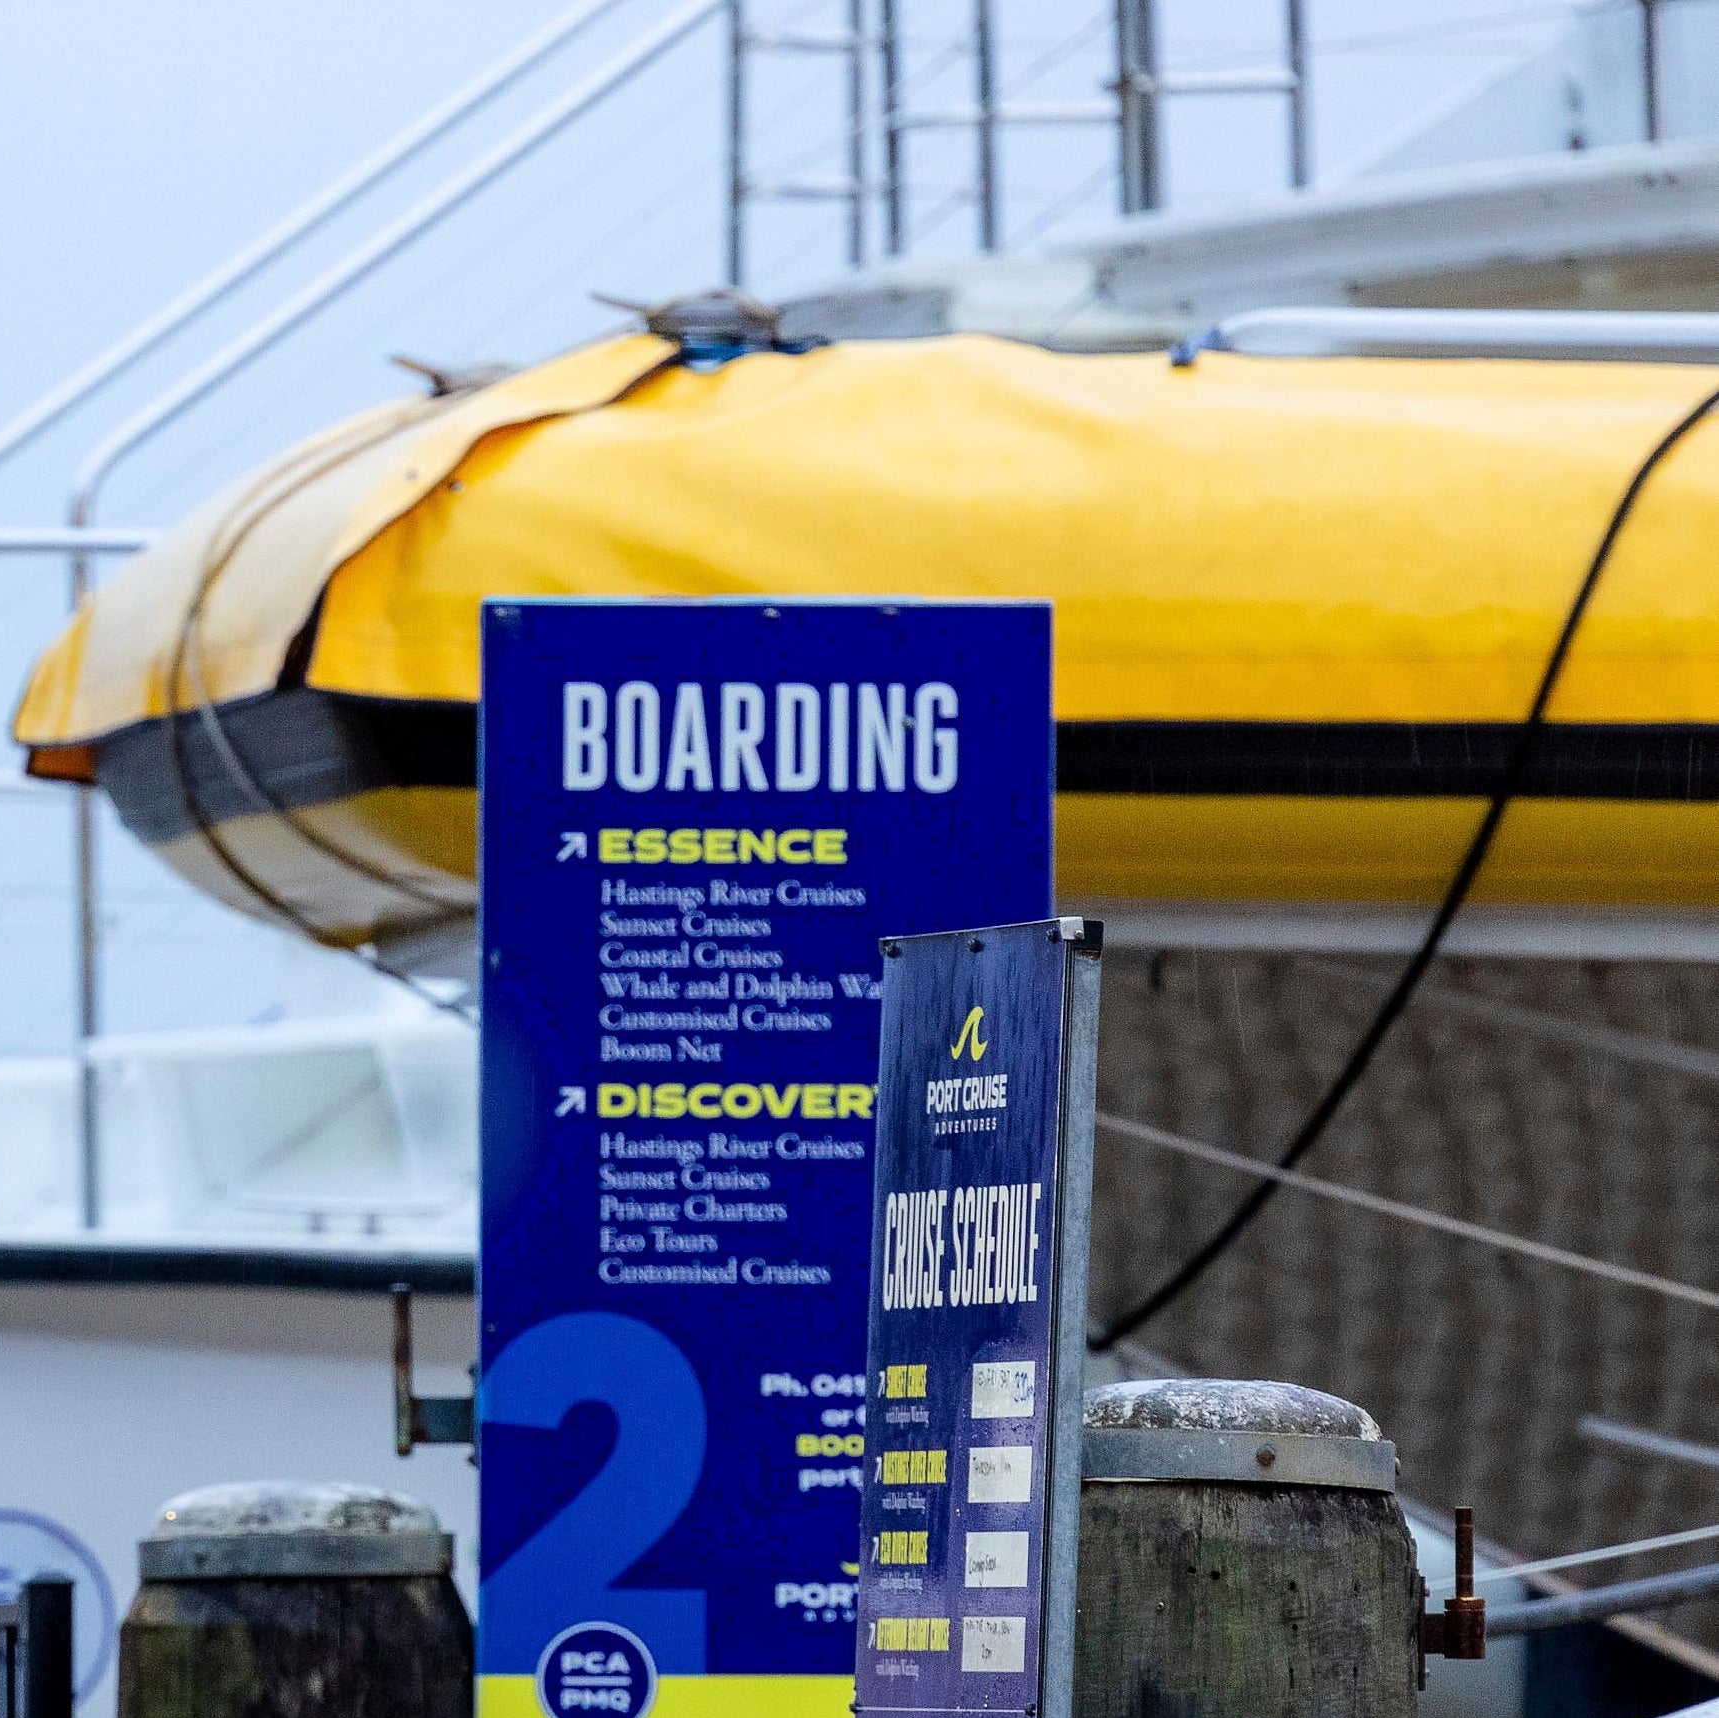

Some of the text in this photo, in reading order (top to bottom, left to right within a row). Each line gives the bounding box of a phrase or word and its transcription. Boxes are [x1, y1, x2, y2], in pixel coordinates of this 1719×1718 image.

[563, 680, 959, 793] BOARDING
[597, 828, 847, 865] ESSENCE
[600, 879, 866, 913] Hastings River Cruises
[599, 910, 771, 937] Sunset Cruises
[599, 941, 783, 968] Coastal Cruises
[599, 971, 883, 1007] Whale and Dolphin Wa
[598, 1003, 832, 1031] Customised Cruises
[600, 1035, 723, 1061] Boom Net
[596, 1082, 879, 1120] DISCOVER
[926, 1074, 1008, 1115] PORT CRUISE
[935, 1117, 997, 1136] ADVENTURES
[600, 1132, 864, 1165] Hastings River Cruises
[598, 1163, 771, 1190] Sunset Cruises
[600, 1194, 788, 1221] Private Charters
[600, 1225, 719, 1252] Eco Tours
[883, 1183, 1041, 1311] CRUISE SCHEDULE
[598, 1256, 831, 1284] Customised Cruises
[760, 1372, 809, 1397] Ph.
[821, 1408, 855, 1427] or
[795, 1433, 865, 1457] BOO
[481, 1311, 707, 1675] 2
[798, 1466, 863, 1493] port
[560, 1651, 631, 1674] PCA
[560, 1688, 631, 1713] PMQ
